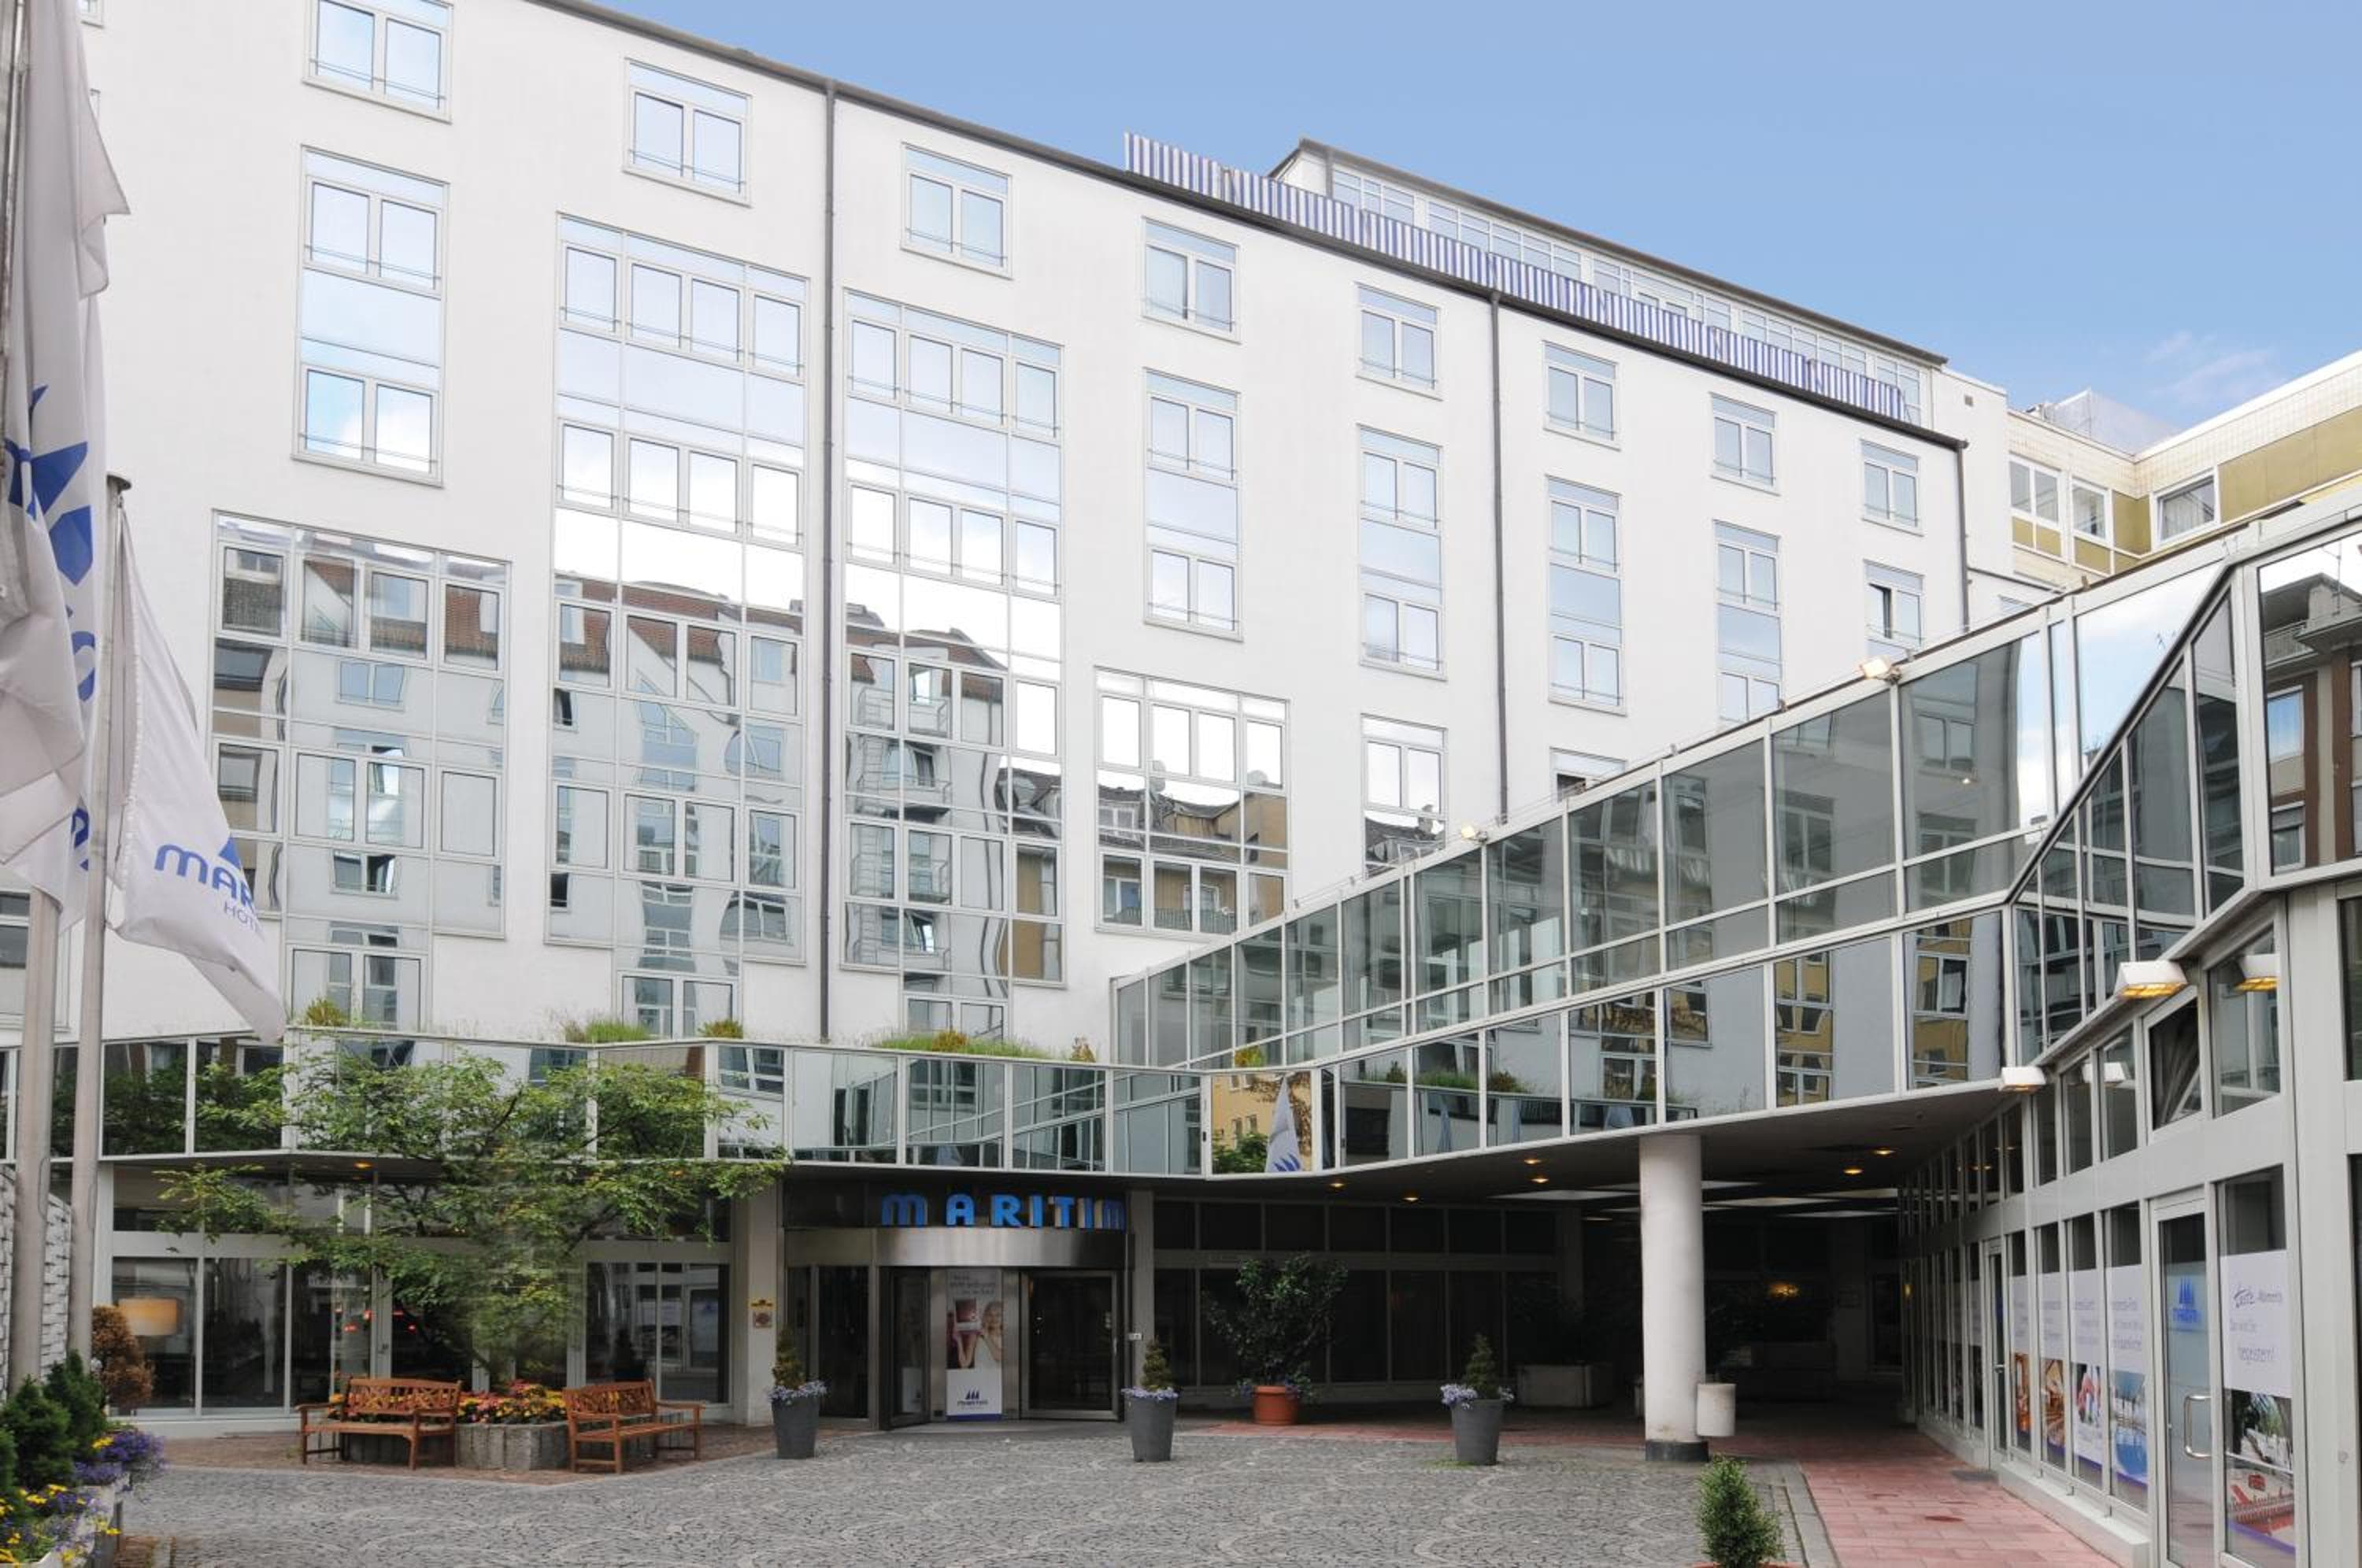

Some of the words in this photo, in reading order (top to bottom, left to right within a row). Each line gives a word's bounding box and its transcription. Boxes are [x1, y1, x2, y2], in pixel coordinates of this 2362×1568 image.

[154, 844, 254, 908] MAR
[224, 900, 258, 932] HOT
[880, 1193, 1126, 1229] MARITIM
